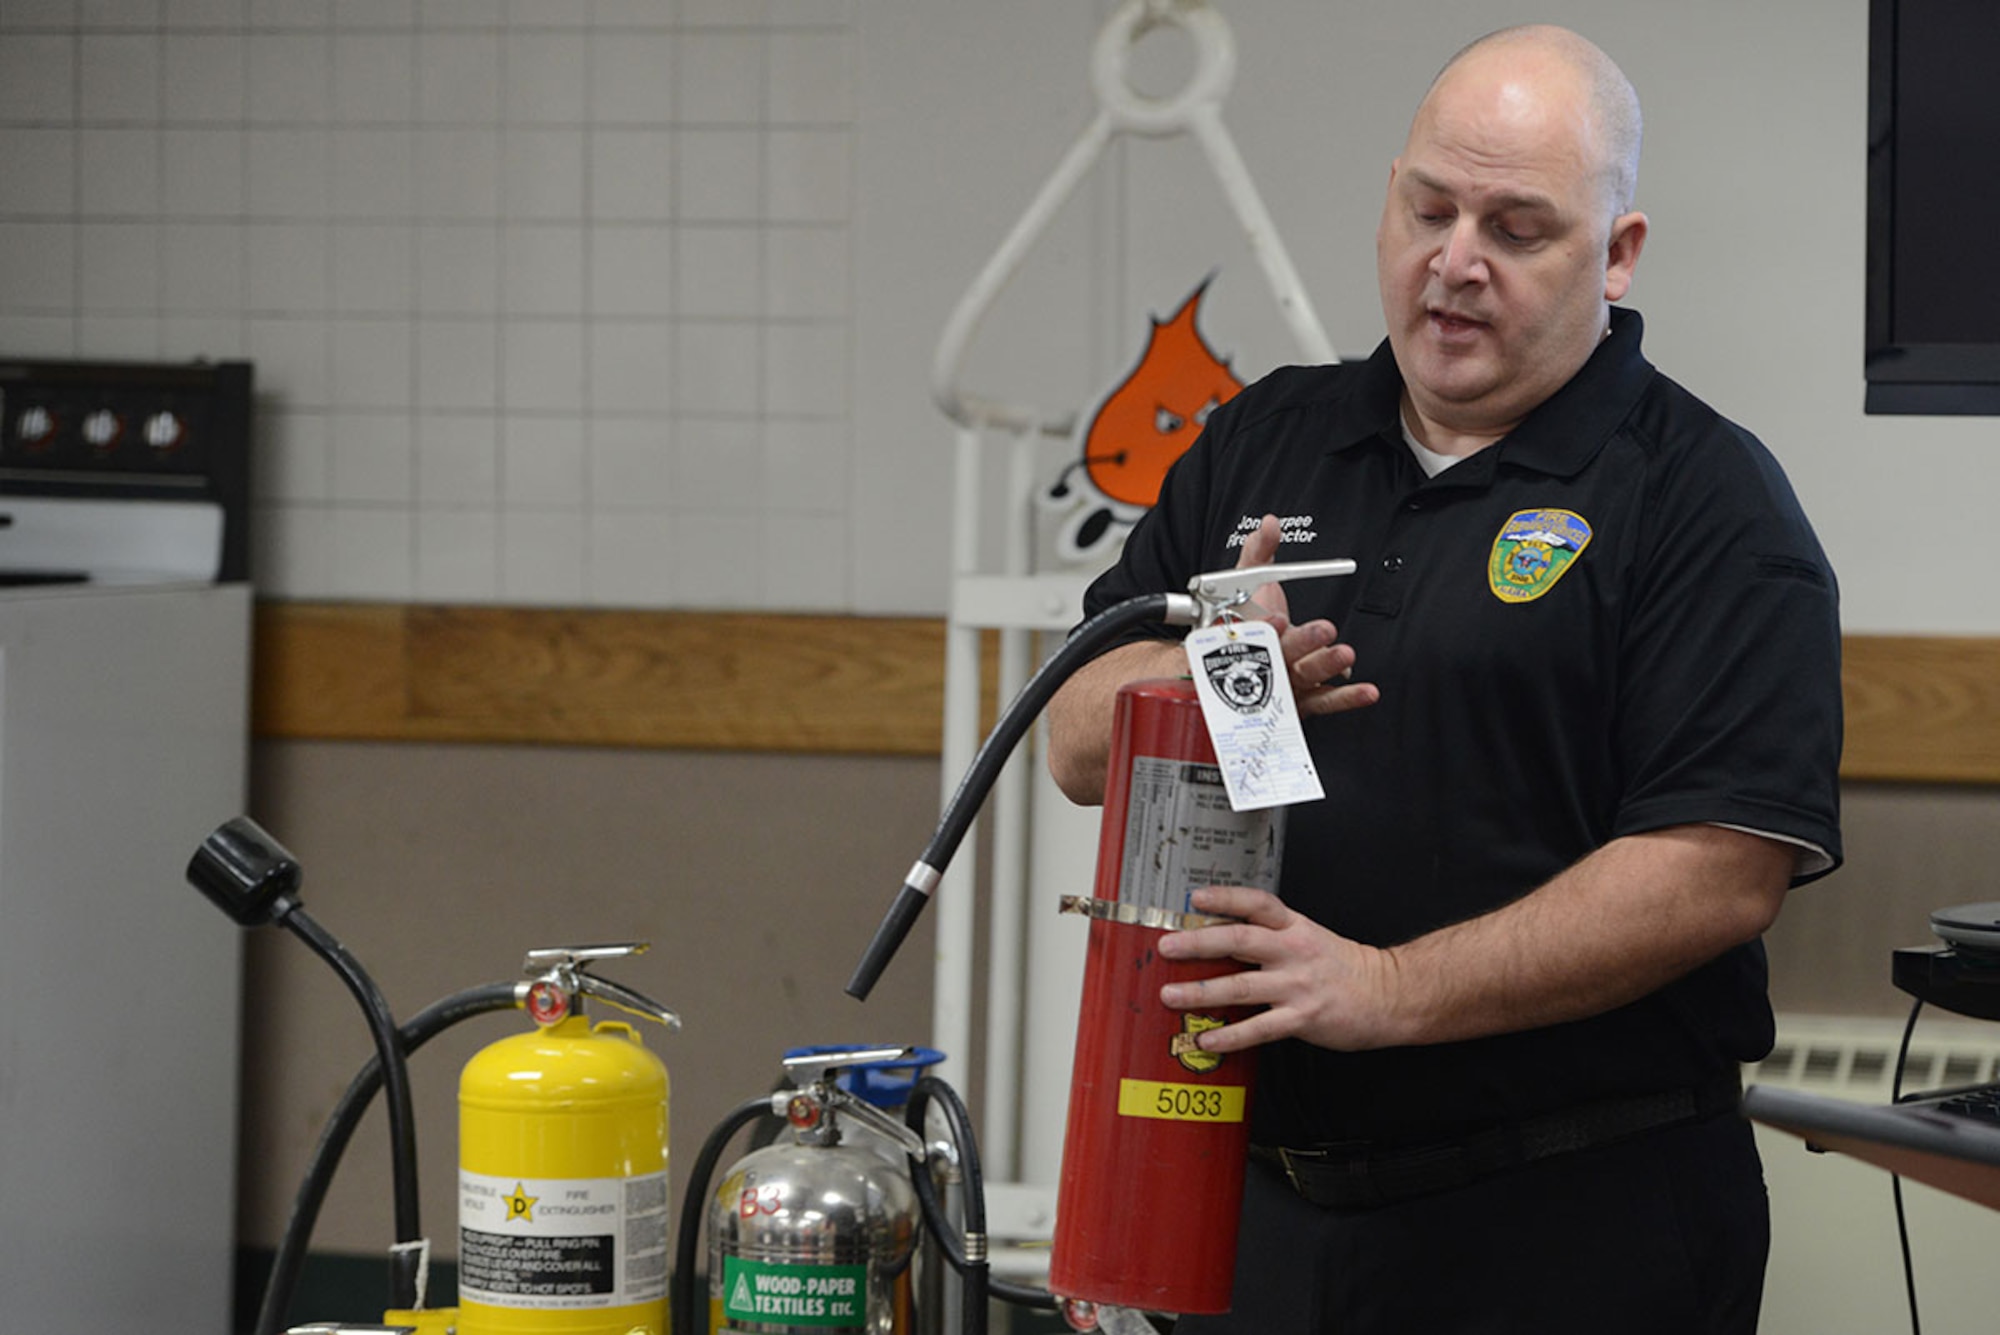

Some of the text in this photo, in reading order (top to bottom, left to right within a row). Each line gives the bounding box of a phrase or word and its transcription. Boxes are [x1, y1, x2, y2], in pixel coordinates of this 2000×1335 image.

[1237, 515, 1313, 531] Jon rpee
[1157, 1088, 1222, 1117] 5033
[513, 1198, 527, 1215] D
[755, 1294, 825, 1316] TEXTILES
